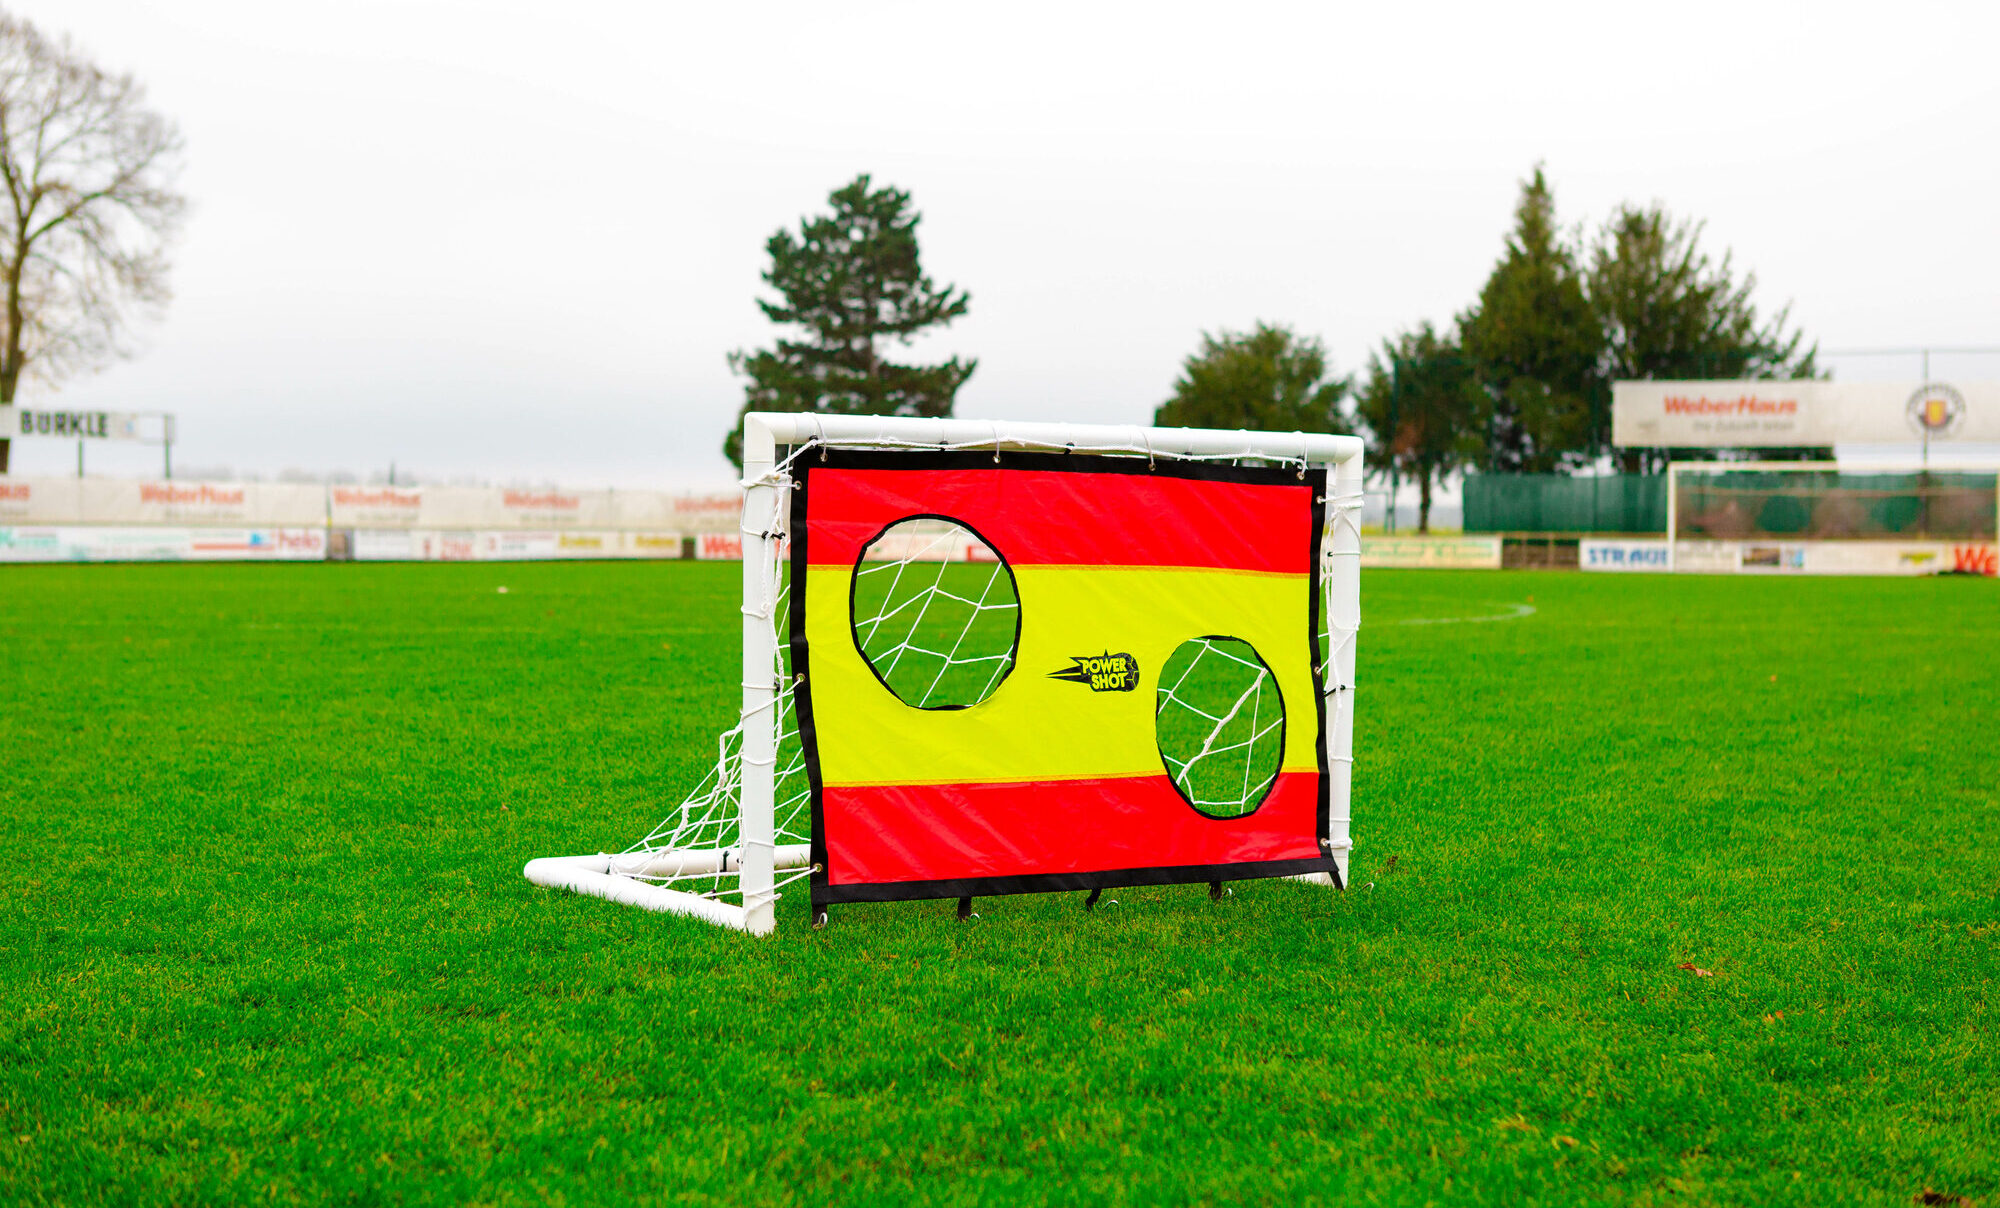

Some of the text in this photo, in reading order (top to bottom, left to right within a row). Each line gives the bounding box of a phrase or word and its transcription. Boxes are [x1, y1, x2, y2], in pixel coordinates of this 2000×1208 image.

[1664, 395, 1797, 415] WeberHaus
[1078, 657, 1128, 674] POWER
[1091, 672, 1128, 690] SHOT
